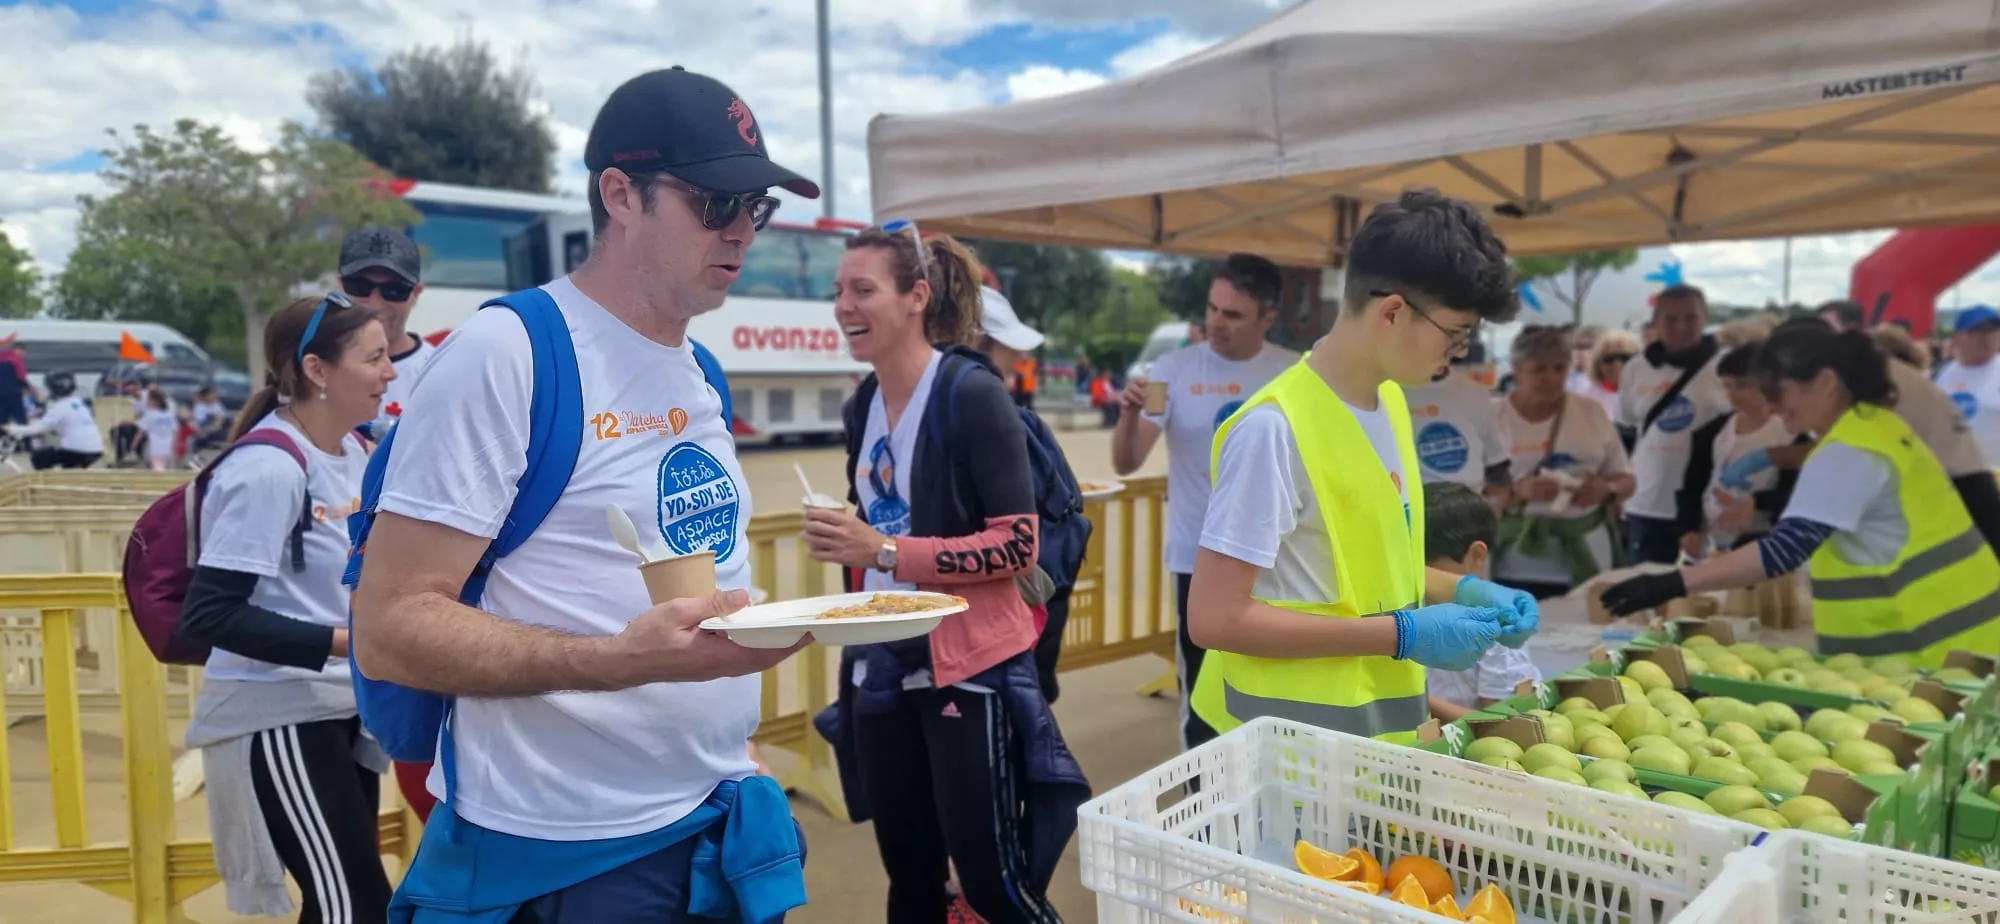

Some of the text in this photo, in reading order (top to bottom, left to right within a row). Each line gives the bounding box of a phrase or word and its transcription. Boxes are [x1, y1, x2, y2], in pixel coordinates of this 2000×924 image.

[1821, 65, 1967, 99] MASTERTENT
[732, 325, 838, 352] avanza
[677, 509, 731, 542] ASPACE
[687, 529, 729, 552] Huesca
[935, 517, 1034, 576] adidas
